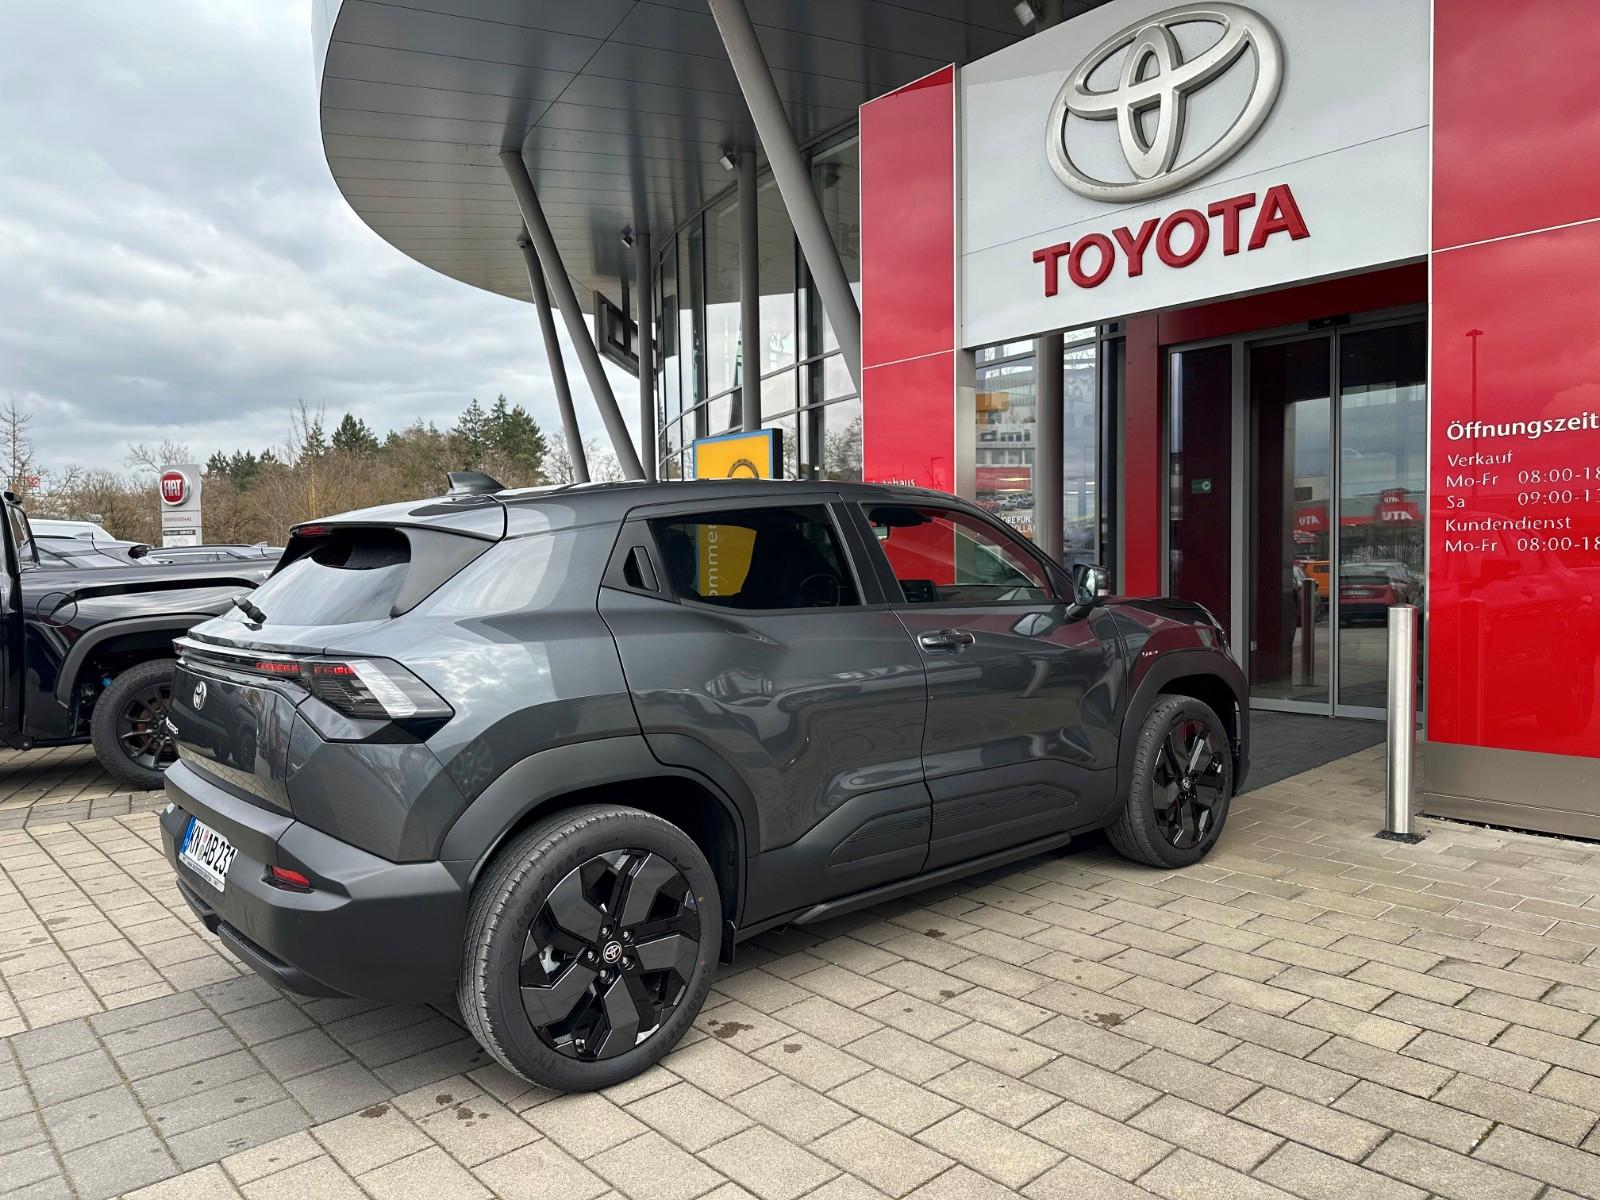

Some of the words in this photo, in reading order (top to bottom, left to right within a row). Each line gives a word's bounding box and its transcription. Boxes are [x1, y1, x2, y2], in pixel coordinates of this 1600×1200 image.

[1033, 183, 1310, 297] TOYOTA
[1446, 411, 1600, 440] Öffnungszeit
[1447, 450, 1513, 467] Verkauf
[163, 479, 181, 496] FIAT
[1446, 472, 1500, 488] Mo-Fr
[1446, 495, 1465, 508] Sa
[1445, 516, 1572, 531] Kundendienst
[1445, 537, 1498, 553] Mo-Fr
[203, 833, 219, 866] AB
[213, 841, 236, 877] 231
